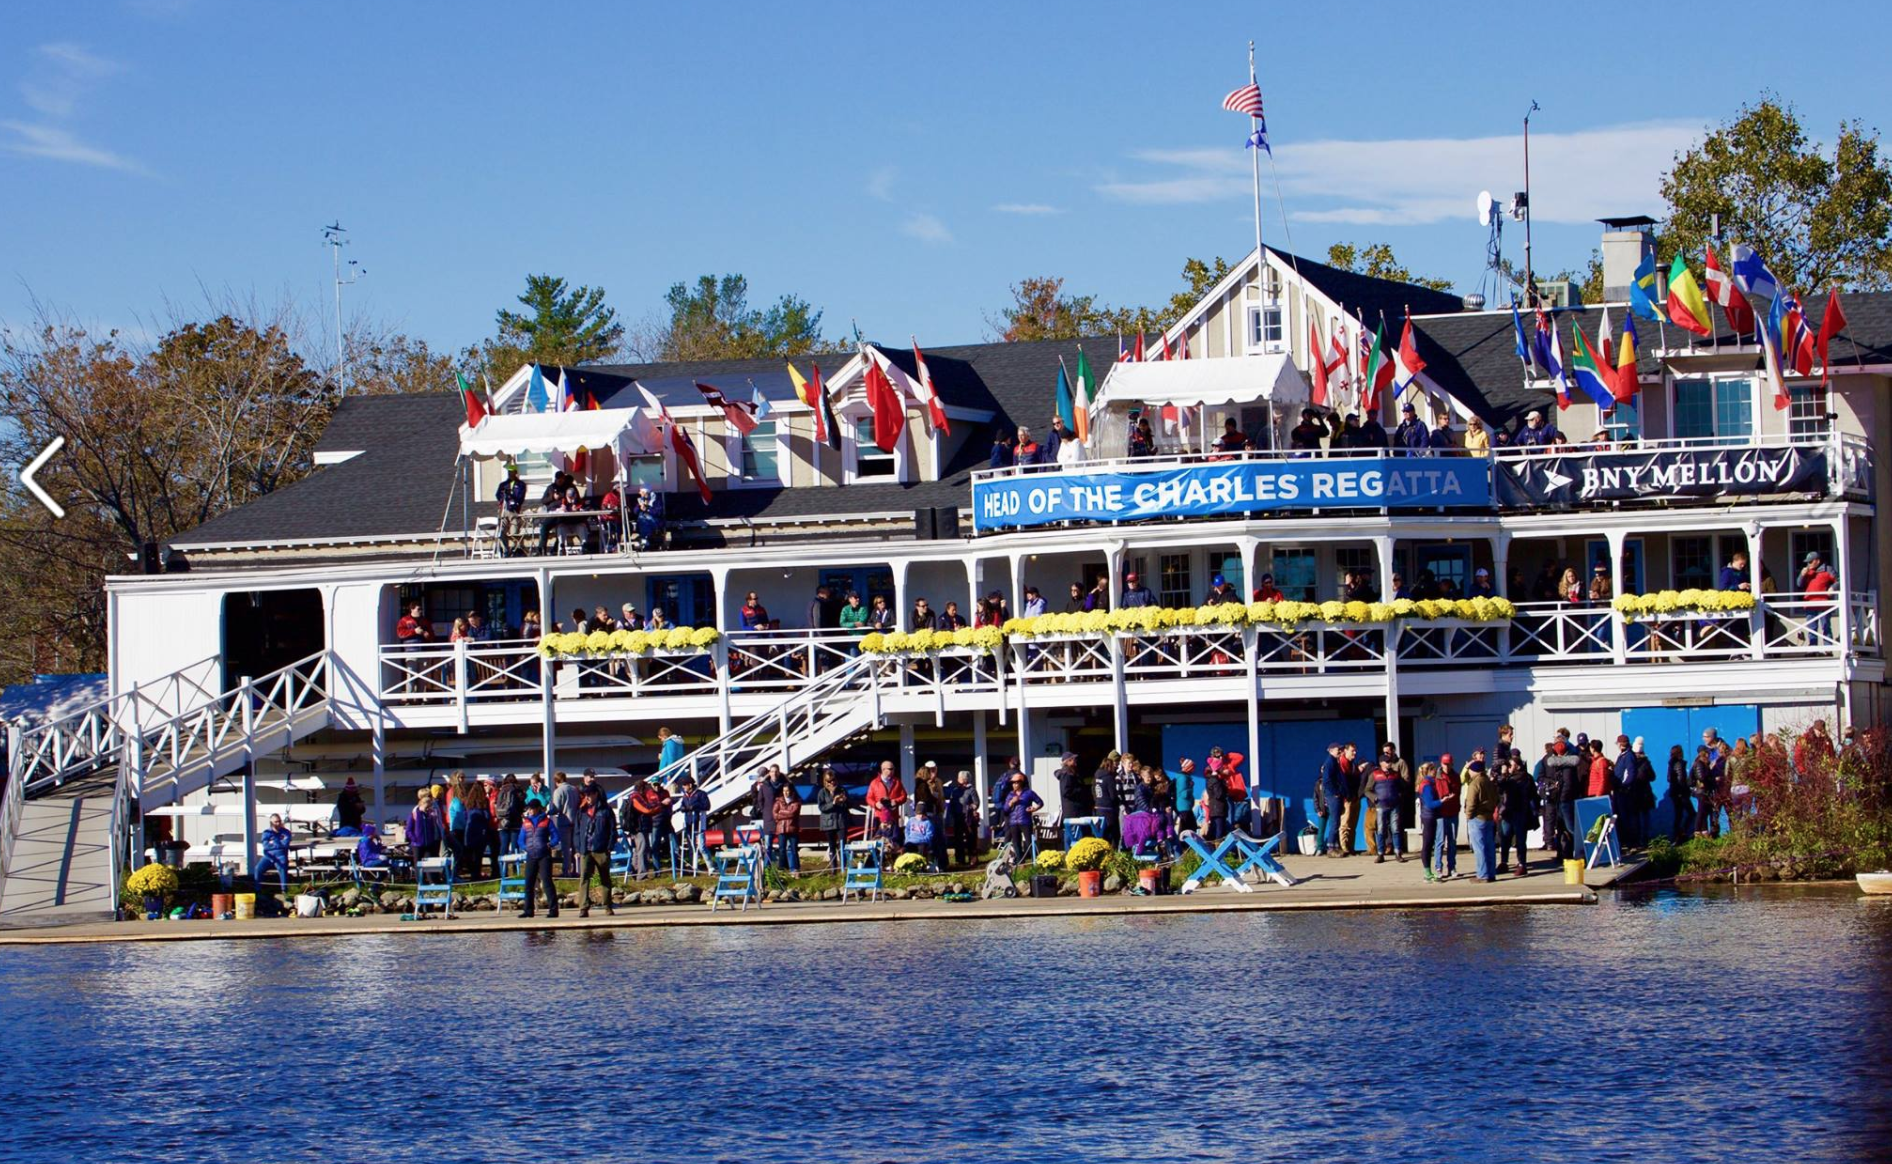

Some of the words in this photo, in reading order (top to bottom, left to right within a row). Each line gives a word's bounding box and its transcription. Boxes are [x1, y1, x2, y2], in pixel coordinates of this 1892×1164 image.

[1582, 467, 1639, 489] BNY
[1651, 460, 1779, 489] MELLON
[984, 490, 1020, 518] HEAD
[1028, 488, 1062, 514] OF
[1069, 485, 1124, 511] THE
[1133, 474, 1299, 508] CHARLES
[1312, 470, 1463, 499] REGATTA
